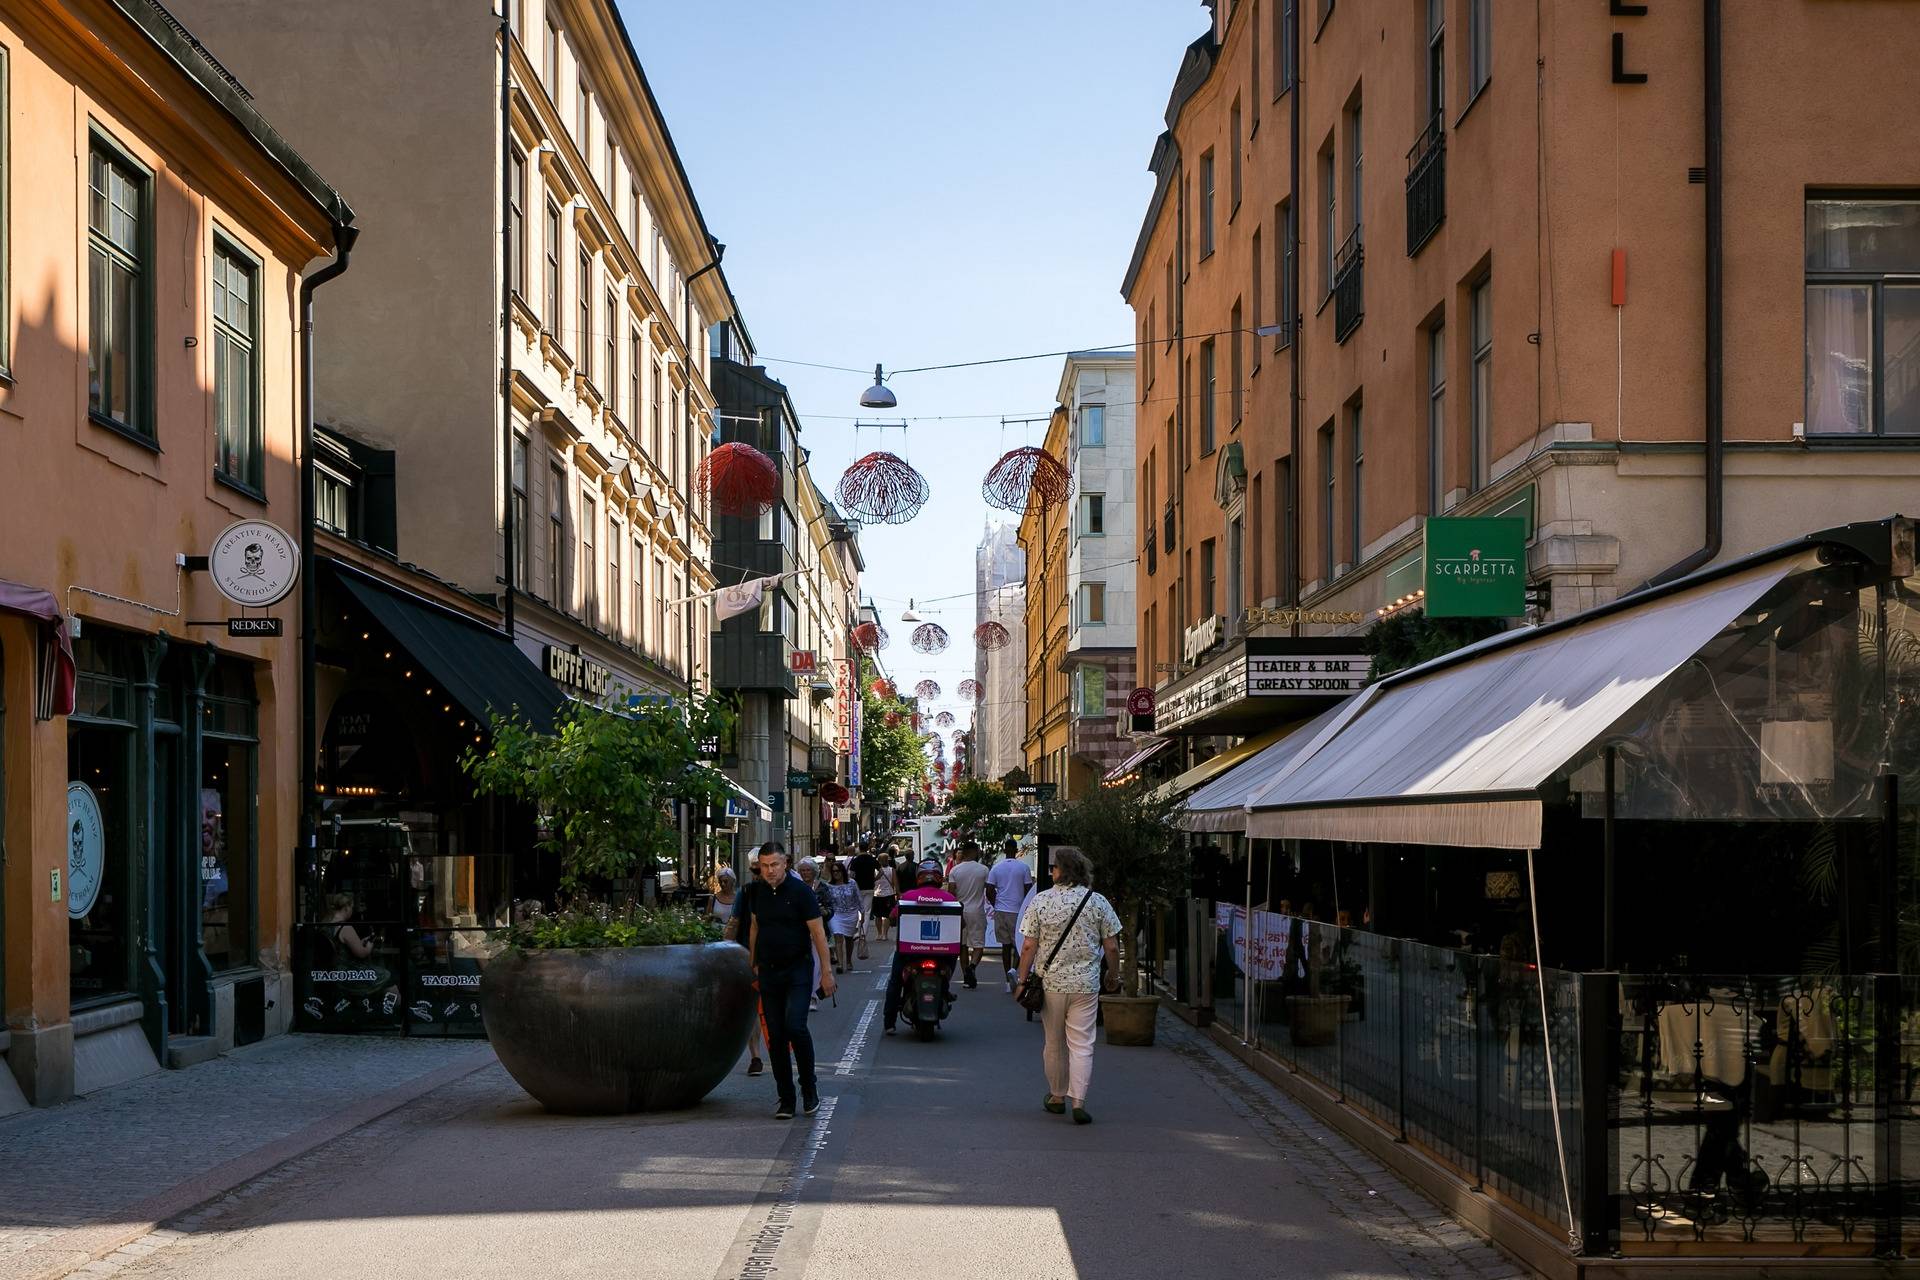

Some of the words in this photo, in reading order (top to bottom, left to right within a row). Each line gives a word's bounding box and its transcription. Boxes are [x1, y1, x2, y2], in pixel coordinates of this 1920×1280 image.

[222, 530, 261, 555] CREATIVE
[264, 533, 287, 560] HEADZ
[1435, 563, 1515, 575] SCARPETTA
[224, 576, 279, 597] STOCKHOLM
[231, 620, 276, 630] REDKEN
[1245, 607, 1364, 629] Playhouse
[792, 651, 816, 669] DA
[1255, 660, 1300, 673] TEATER
[1308, 660, 1316, 672] &
[1325, 660, 1350, 672] BAR
[584, 660, 608, 696] NERO
[1256, 678, 1302, 691] GREASY
[1308, 678, 1349, 691] SPOON
[838, 664, 848, 750] SKANDIA
[311, 970, 348, 982] TACO
[348, 969, 377, 981] BAR
[422, 975, 457, 986] TACO
